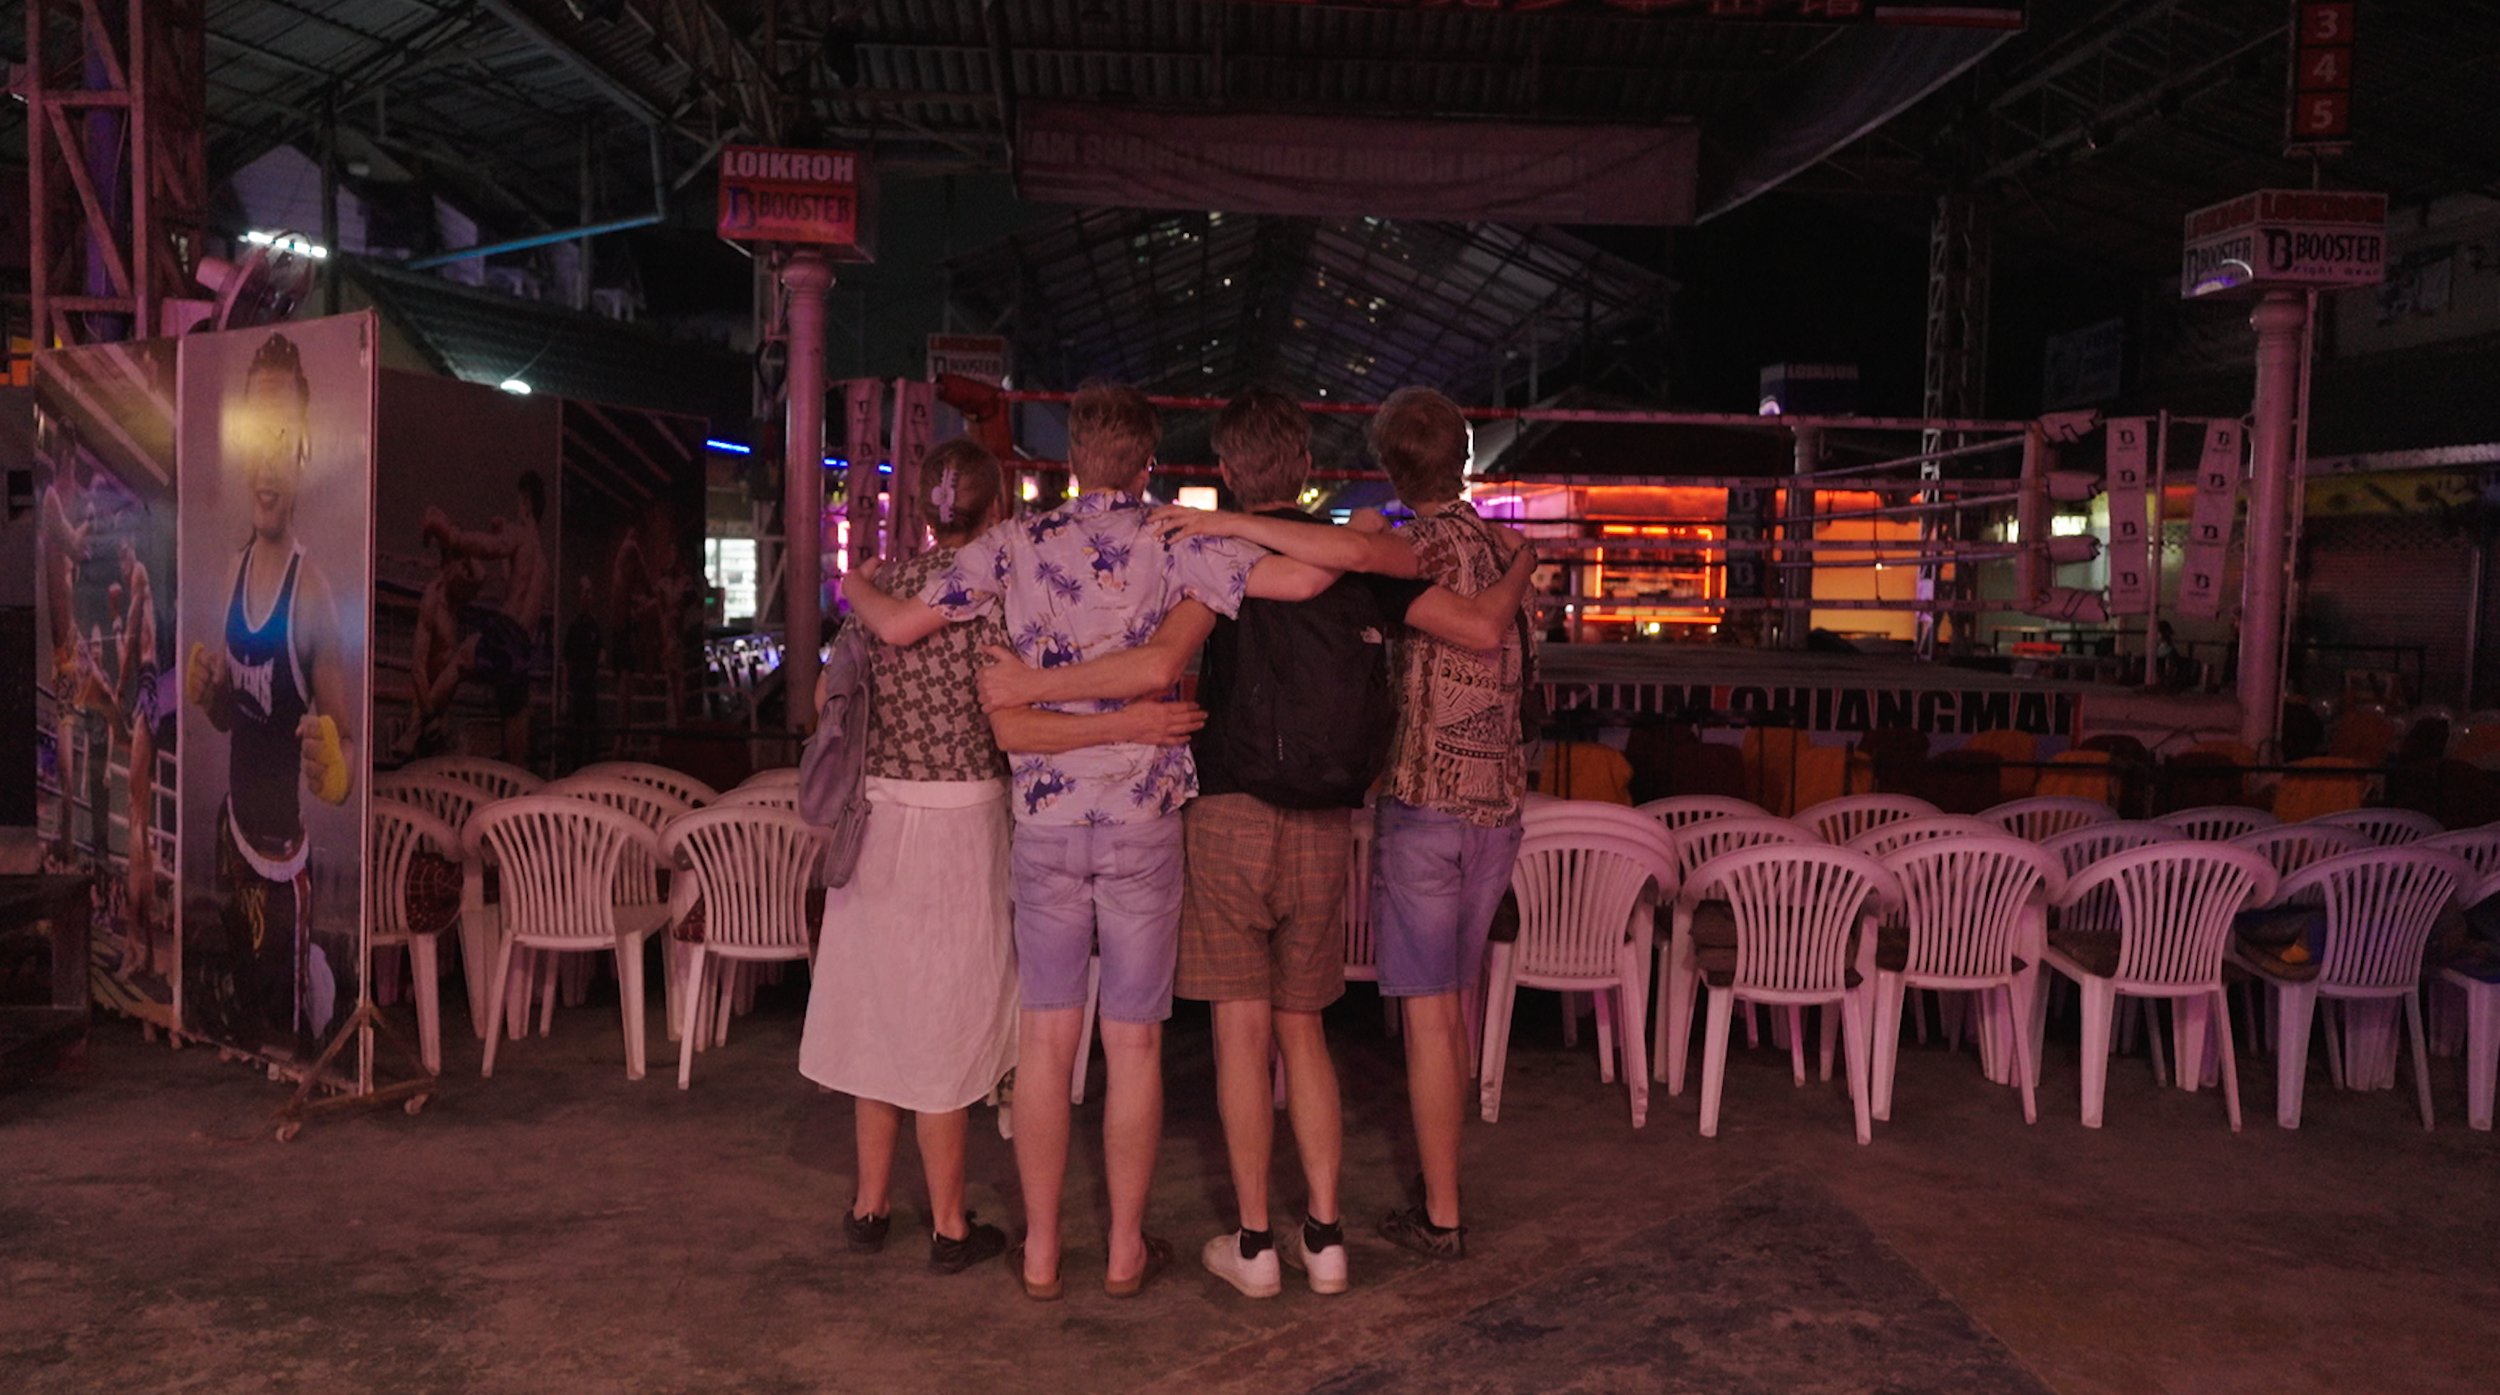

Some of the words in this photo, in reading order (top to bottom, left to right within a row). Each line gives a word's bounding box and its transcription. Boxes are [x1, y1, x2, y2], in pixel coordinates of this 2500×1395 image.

[2317, 9, 2339, 39] 3
[2312, 53, 2337, 83] 4
[2312, 99, 2333, 130] 5
[723, 151, 854, 182] LOIKROH
[759, 191, 850, 223] BOOSTER
[2296, 232, 2381, 264] BOOSTER
